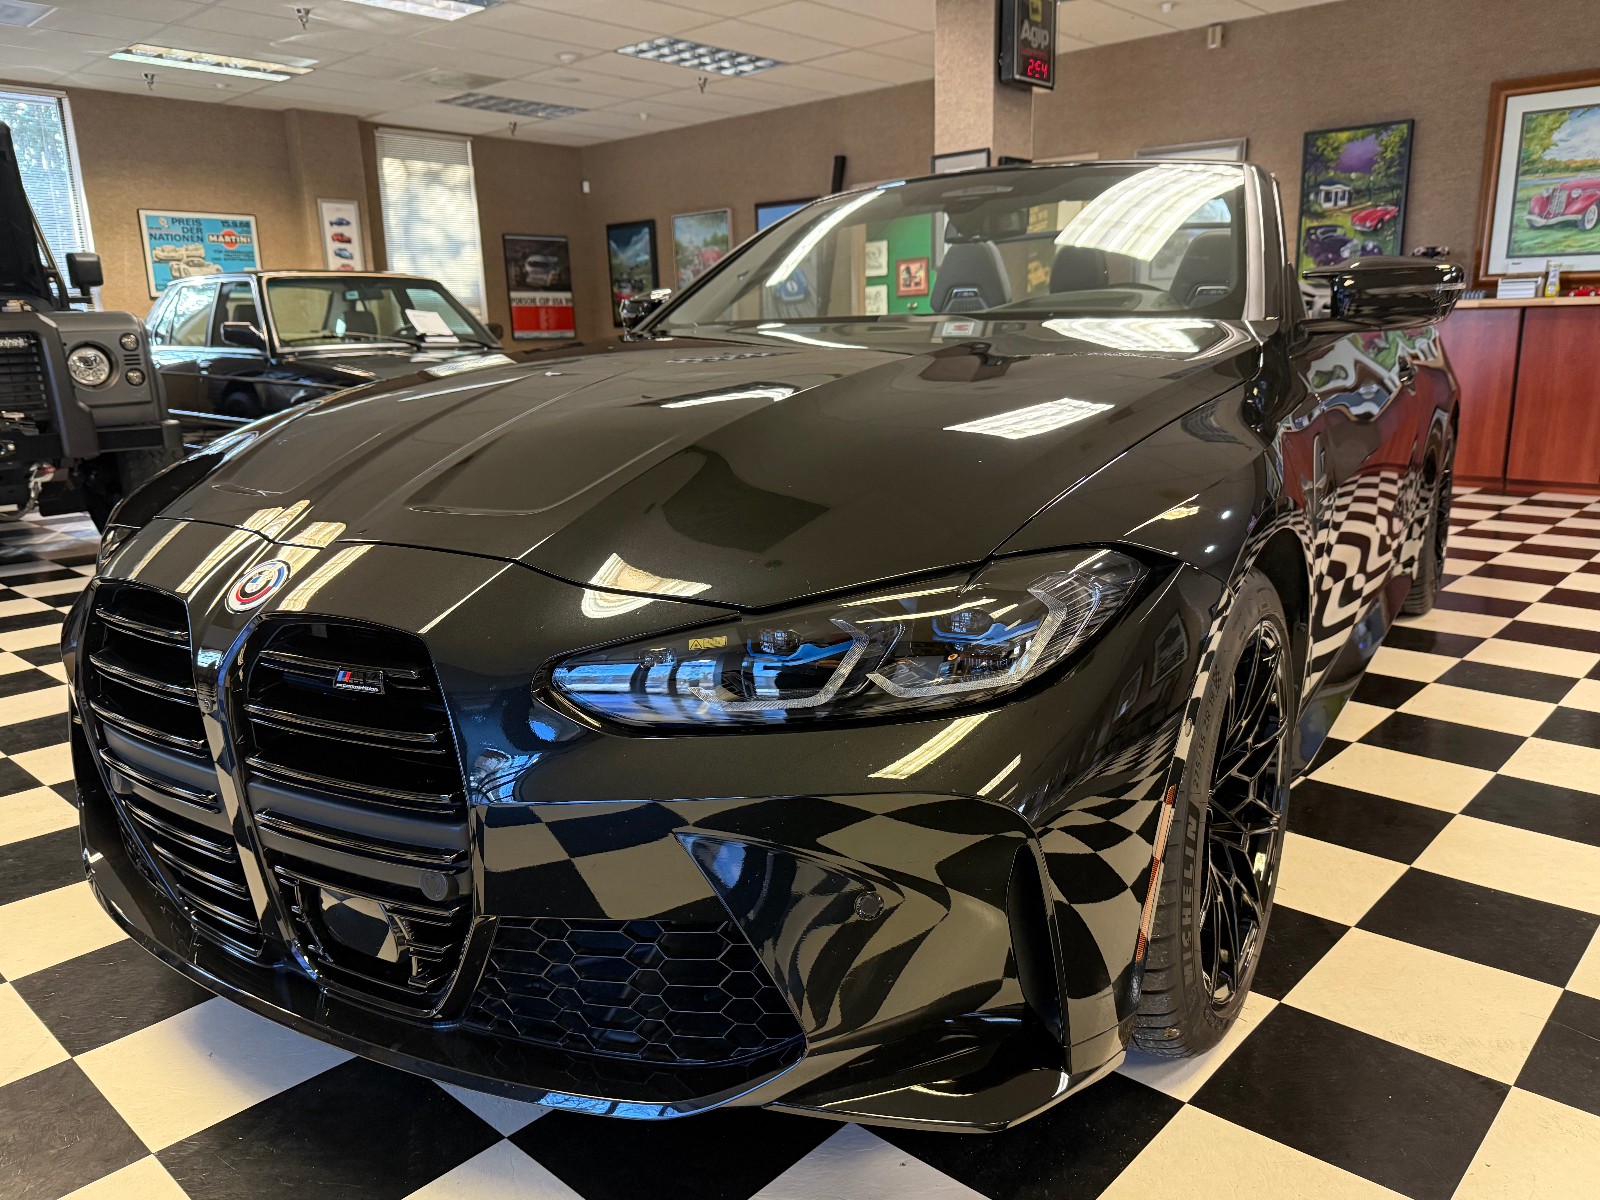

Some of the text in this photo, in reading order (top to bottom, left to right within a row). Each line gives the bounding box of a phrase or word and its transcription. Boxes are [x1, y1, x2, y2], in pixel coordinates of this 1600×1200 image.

[171, 217, 202, 226] PREIS
[181, 226, 203, 234] DER
[149, 233, 204, 243] NATIONEN
[208, 233, 252, 245] MARTINI
[1181, 813, 1198, 988] MICHELIN
